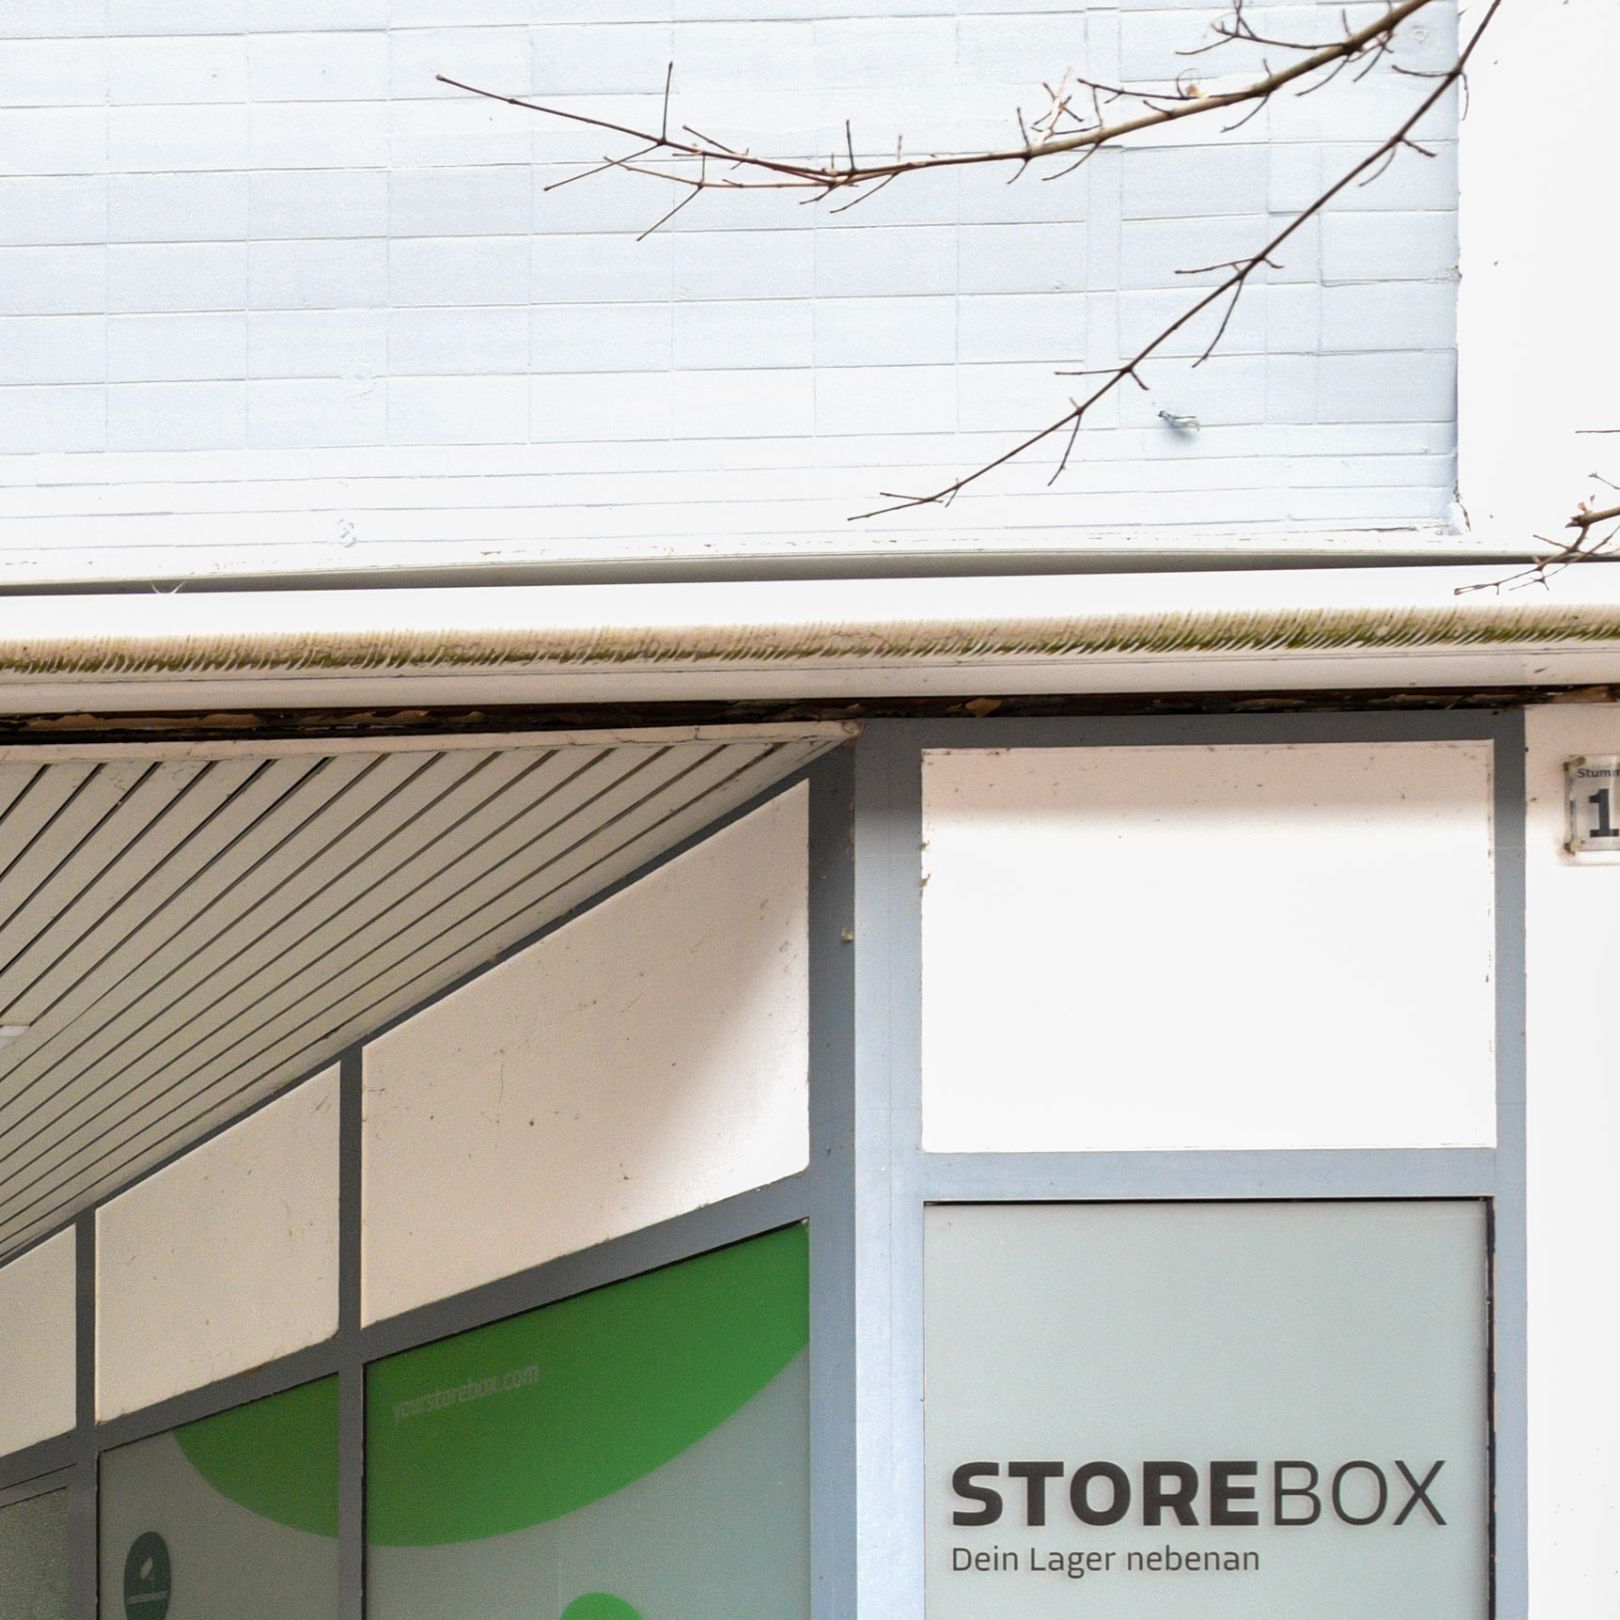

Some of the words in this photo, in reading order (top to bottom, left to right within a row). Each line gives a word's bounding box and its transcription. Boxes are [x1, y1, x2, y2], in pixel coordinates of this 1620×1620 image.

[1588, 788, 1619, 837] 1
[951, 1459, 1448, 1527] STOREBOX
[951, 1547, 1019, 1572] Dein
[1029, 1547, 1116, 1579] Lager
[1126, 1545, 1261, 1572] nebenan
